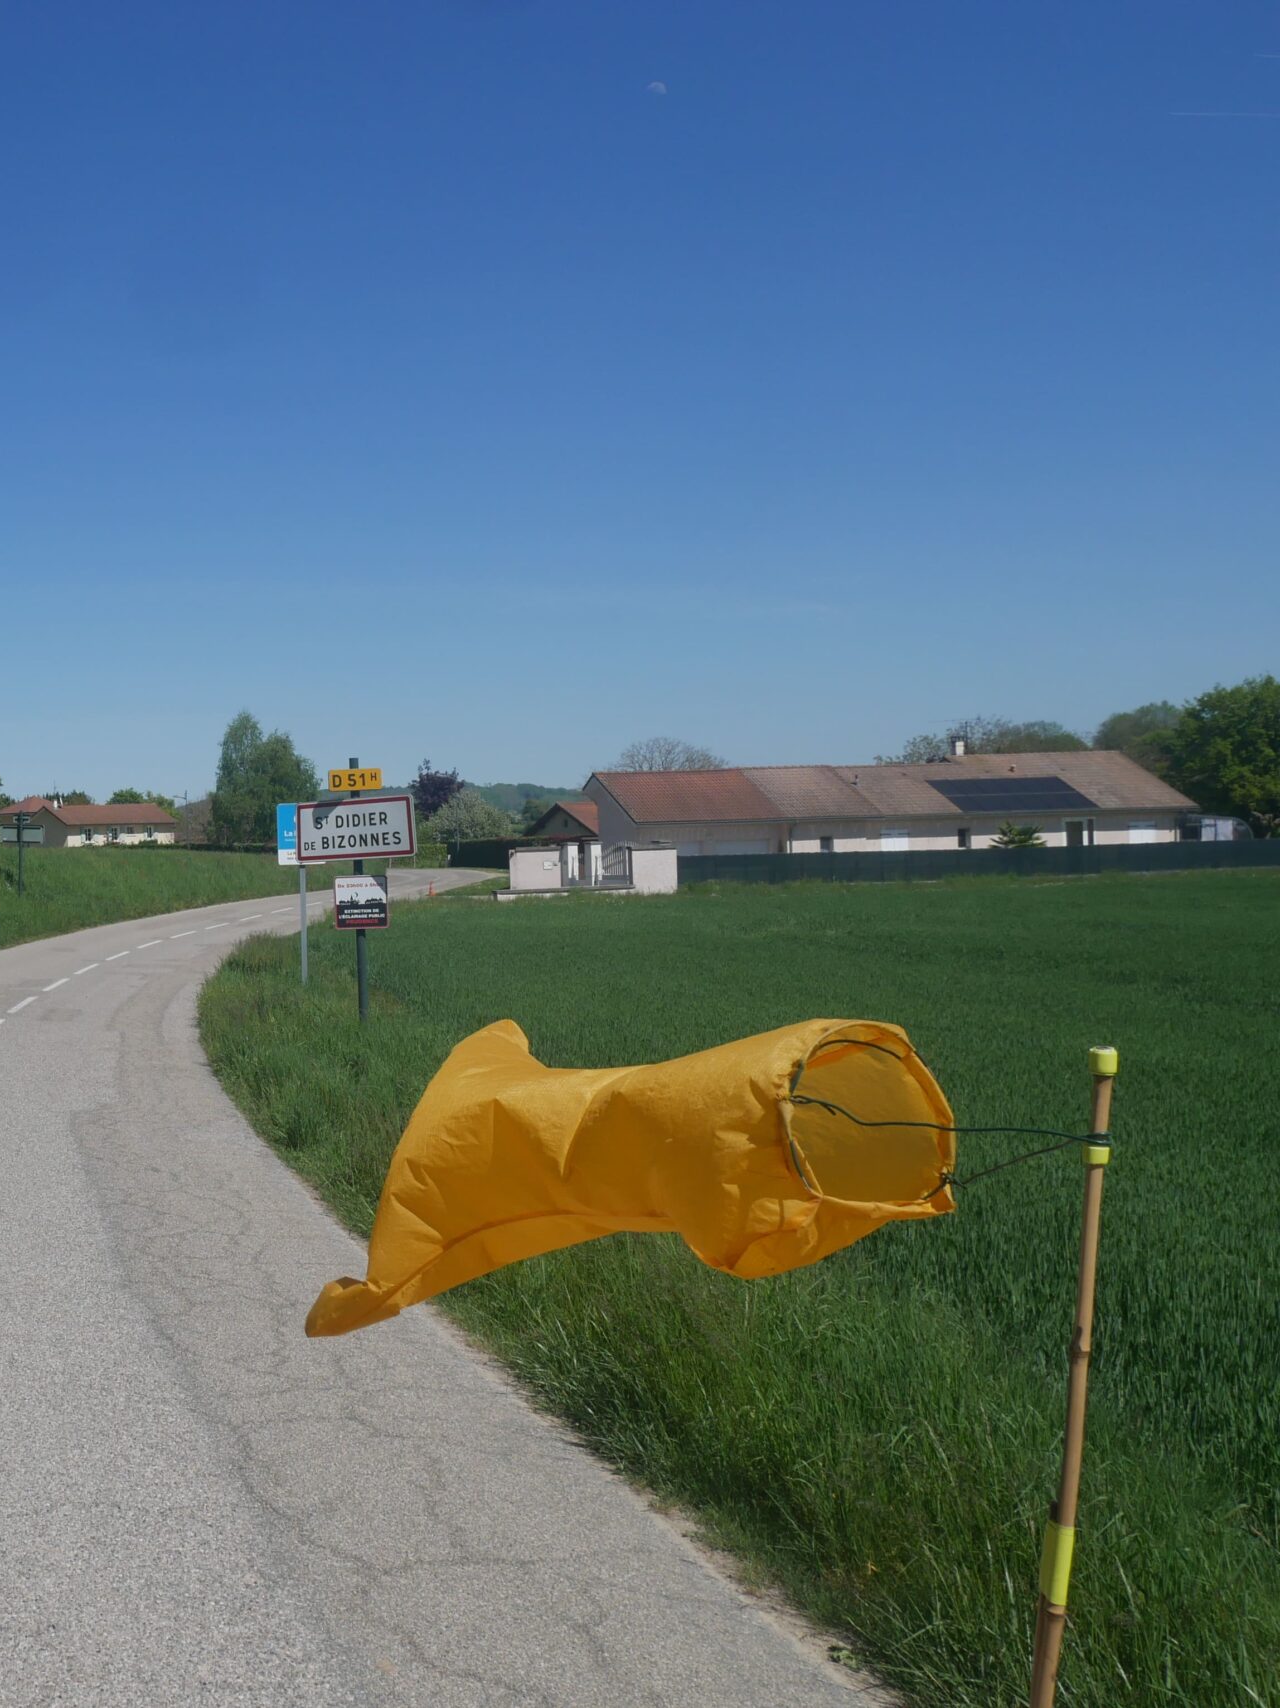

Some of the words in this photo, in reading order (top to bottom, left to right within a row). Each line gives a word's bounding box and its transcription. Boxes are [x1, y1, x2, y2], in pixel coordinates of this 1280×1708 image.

[335, 811, 388, 829] DIDIER
[303, 841, 316, 851] DE
[321, 831, 402, 850] BIZONNES
